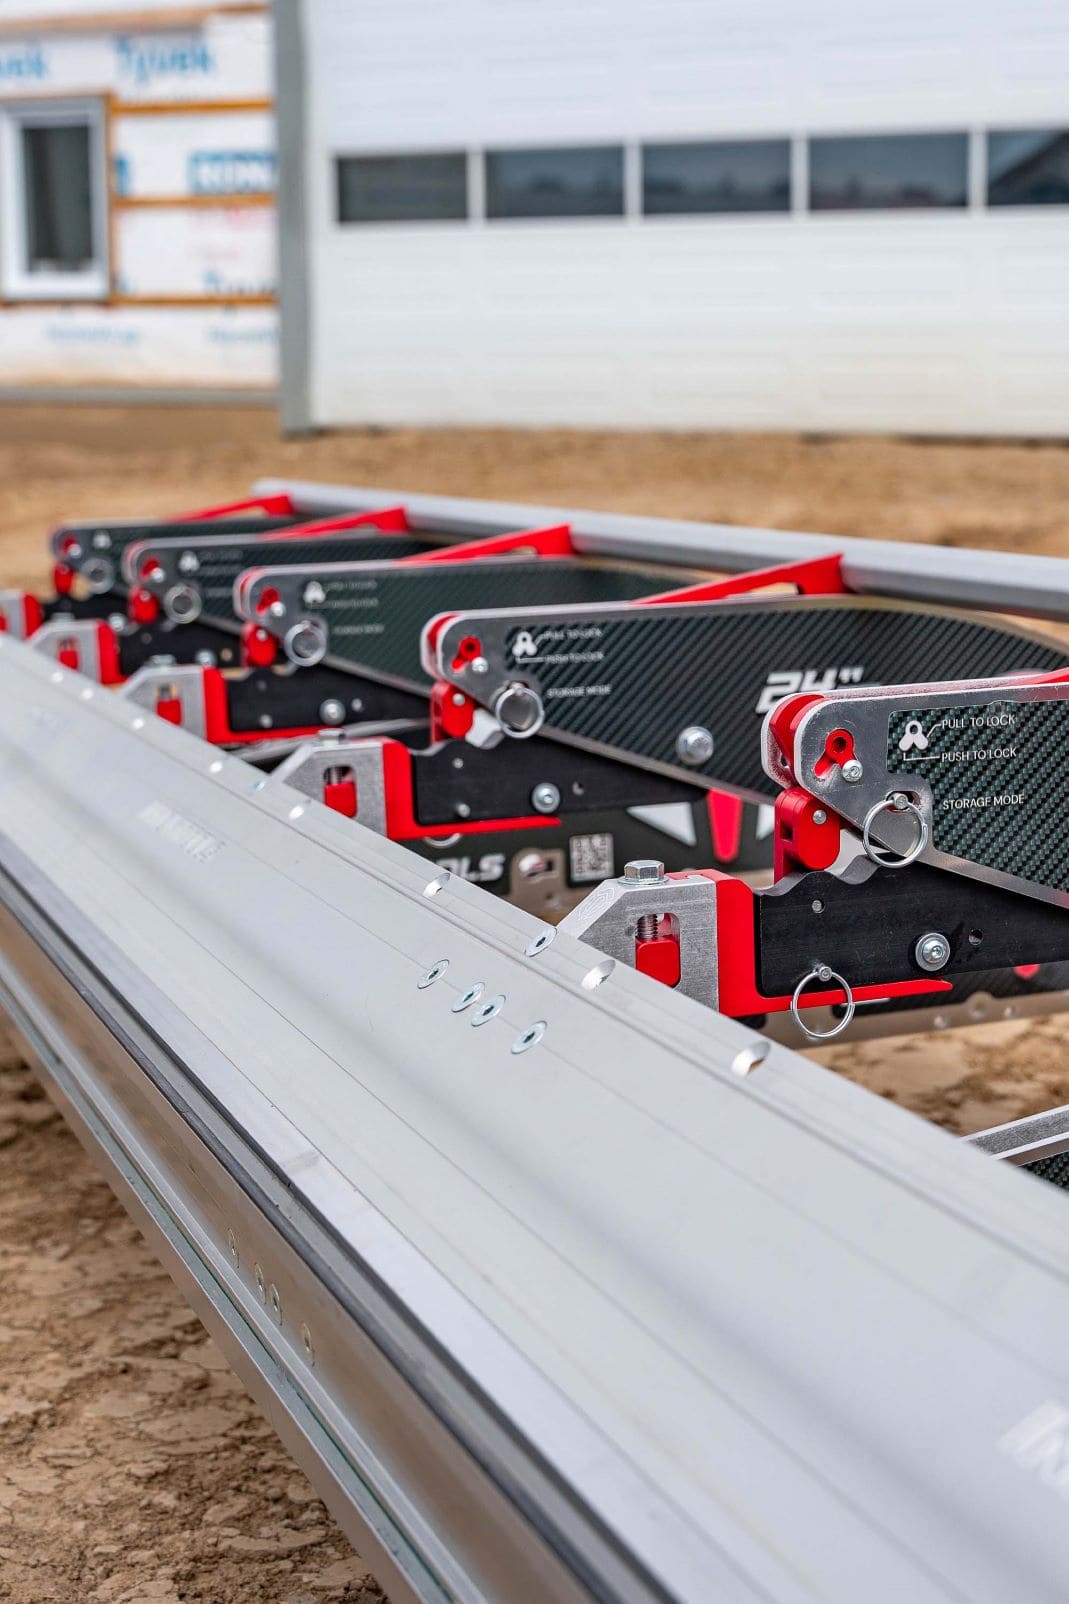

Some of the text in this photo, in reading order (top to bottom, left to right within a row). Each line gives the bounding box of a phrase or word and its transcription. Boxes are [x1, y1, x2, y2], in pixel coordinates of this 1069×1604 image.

[941, 713, 1016, 730] PULL TO LOCK
[941, 747, 1017, 763] PUSH TO LOCK
[942, 793, 1025, 811] STORAGE MODE
